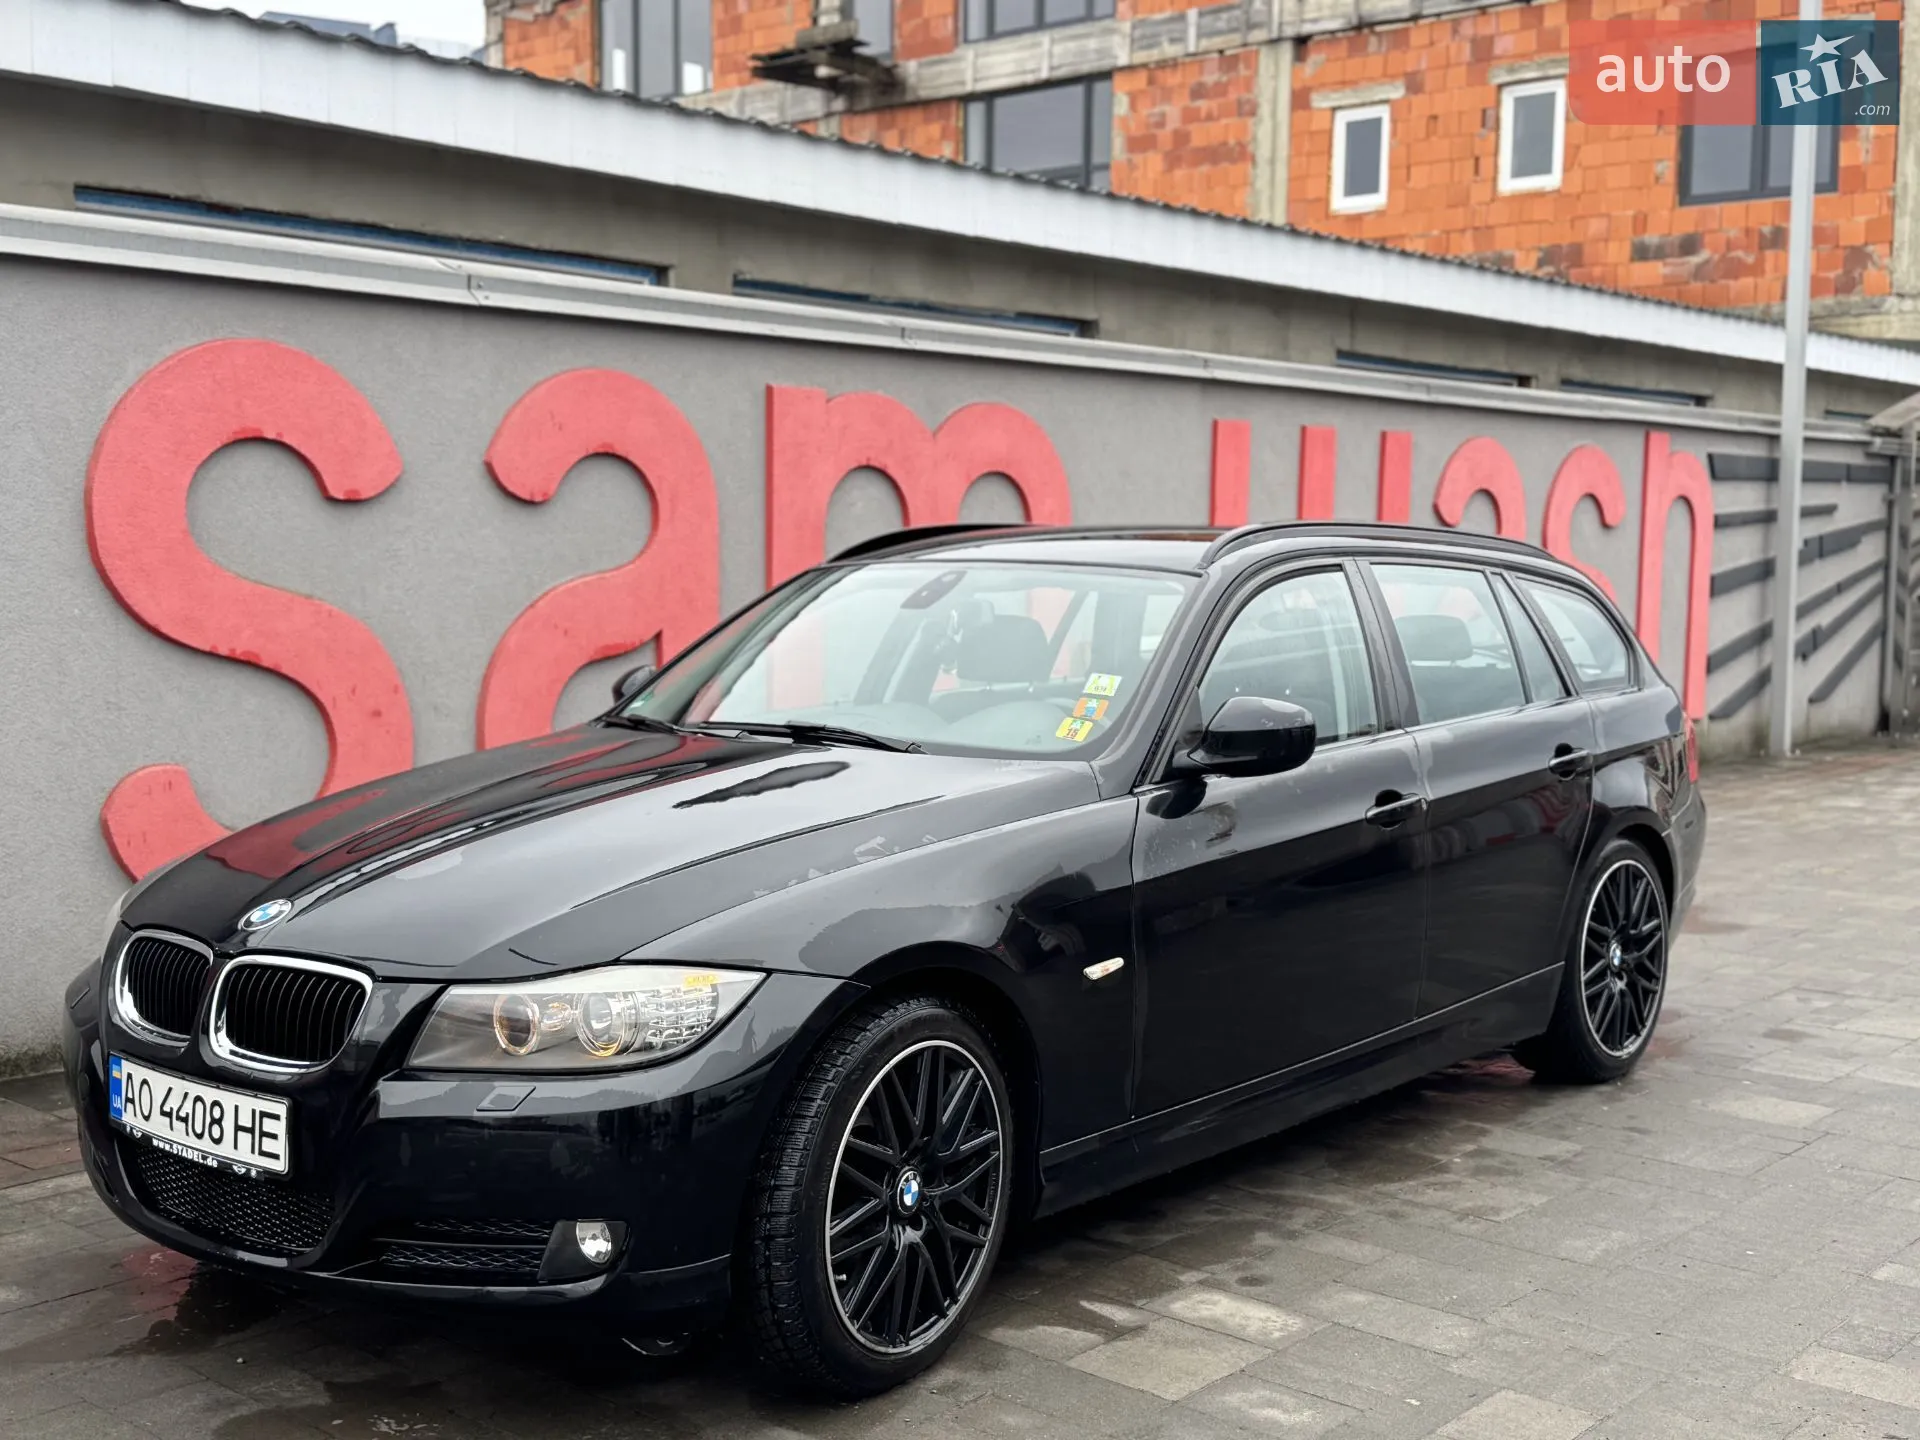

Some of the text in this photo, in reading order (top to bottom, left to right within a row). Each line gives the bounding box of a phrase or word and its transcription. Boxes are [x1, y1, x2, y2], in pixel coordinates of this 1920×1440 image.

[113, 1096, 122, 1110] UA
[124, 1072, 281, 1161] AO 4408 HE
[152, 1138, 218, 1168] www.STADEL.de
